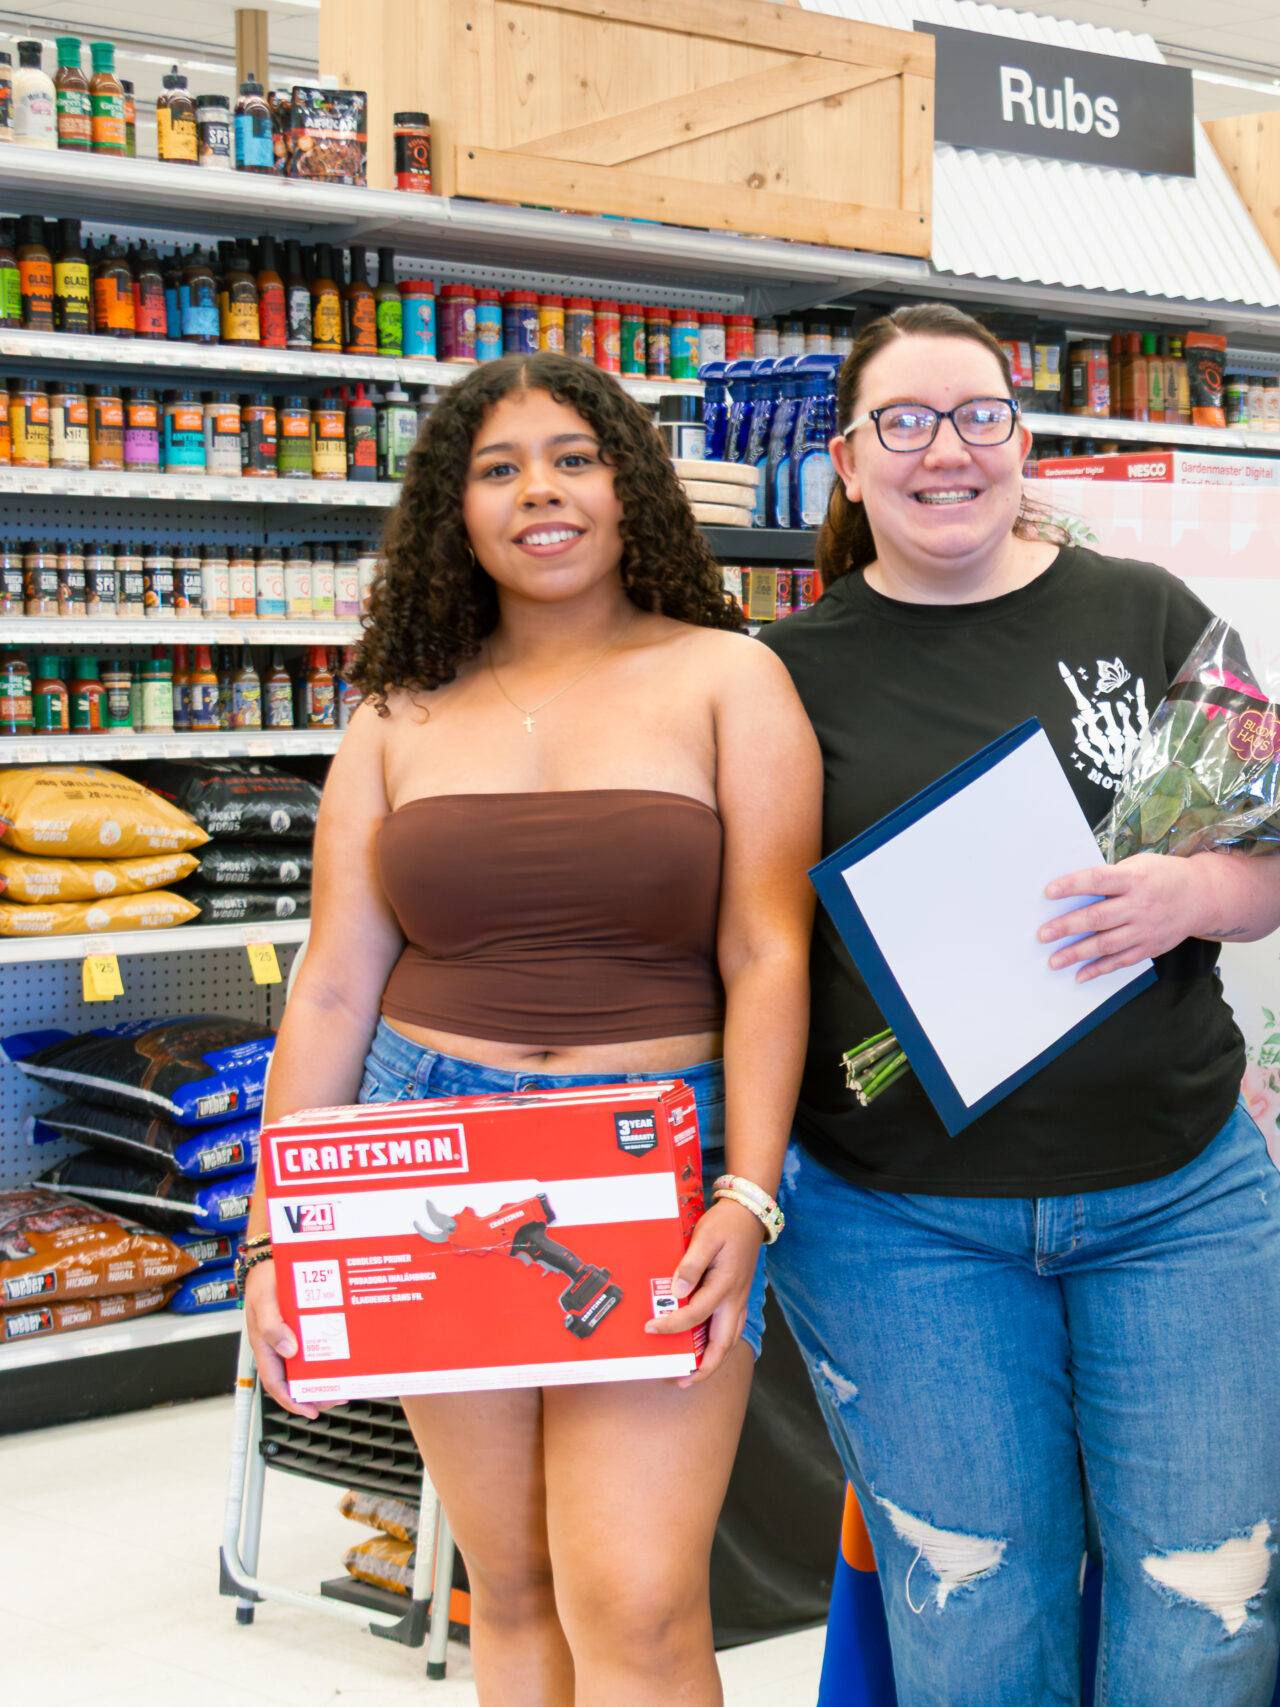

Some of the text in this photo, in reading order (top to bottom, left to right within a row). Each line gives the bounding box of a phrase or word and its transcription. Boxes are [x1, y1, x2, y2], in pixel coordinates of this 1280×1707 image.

[1000, 65, 1120, 138] Rubs
[1128, 463, 1166, 478] NESCO
[1181, 461, 1273, 480] Gardenmaster Digital
[1237, 729, 1270, 750] HAUS
[1243, 720, 1277, 741] BLOOM
[200, 1094, 230, 1116] weber
[618, 1119, 653, 1136] 3 YEAR
[202, 1145, 233, 1169] weber
[285, 1137, 453, 1173] CRAFTSMAN
[283, 1203, 333, 1233] V20
[489, 1210, 525, 1229] CRAFTSMAN
[346, 1254, 412, 1267] CORDLESS PRUNER
[9, 1275, 44, 1298] weber
[197, 1283, 229, 1303] weber
[8, 1315, 41, 1336] weber
